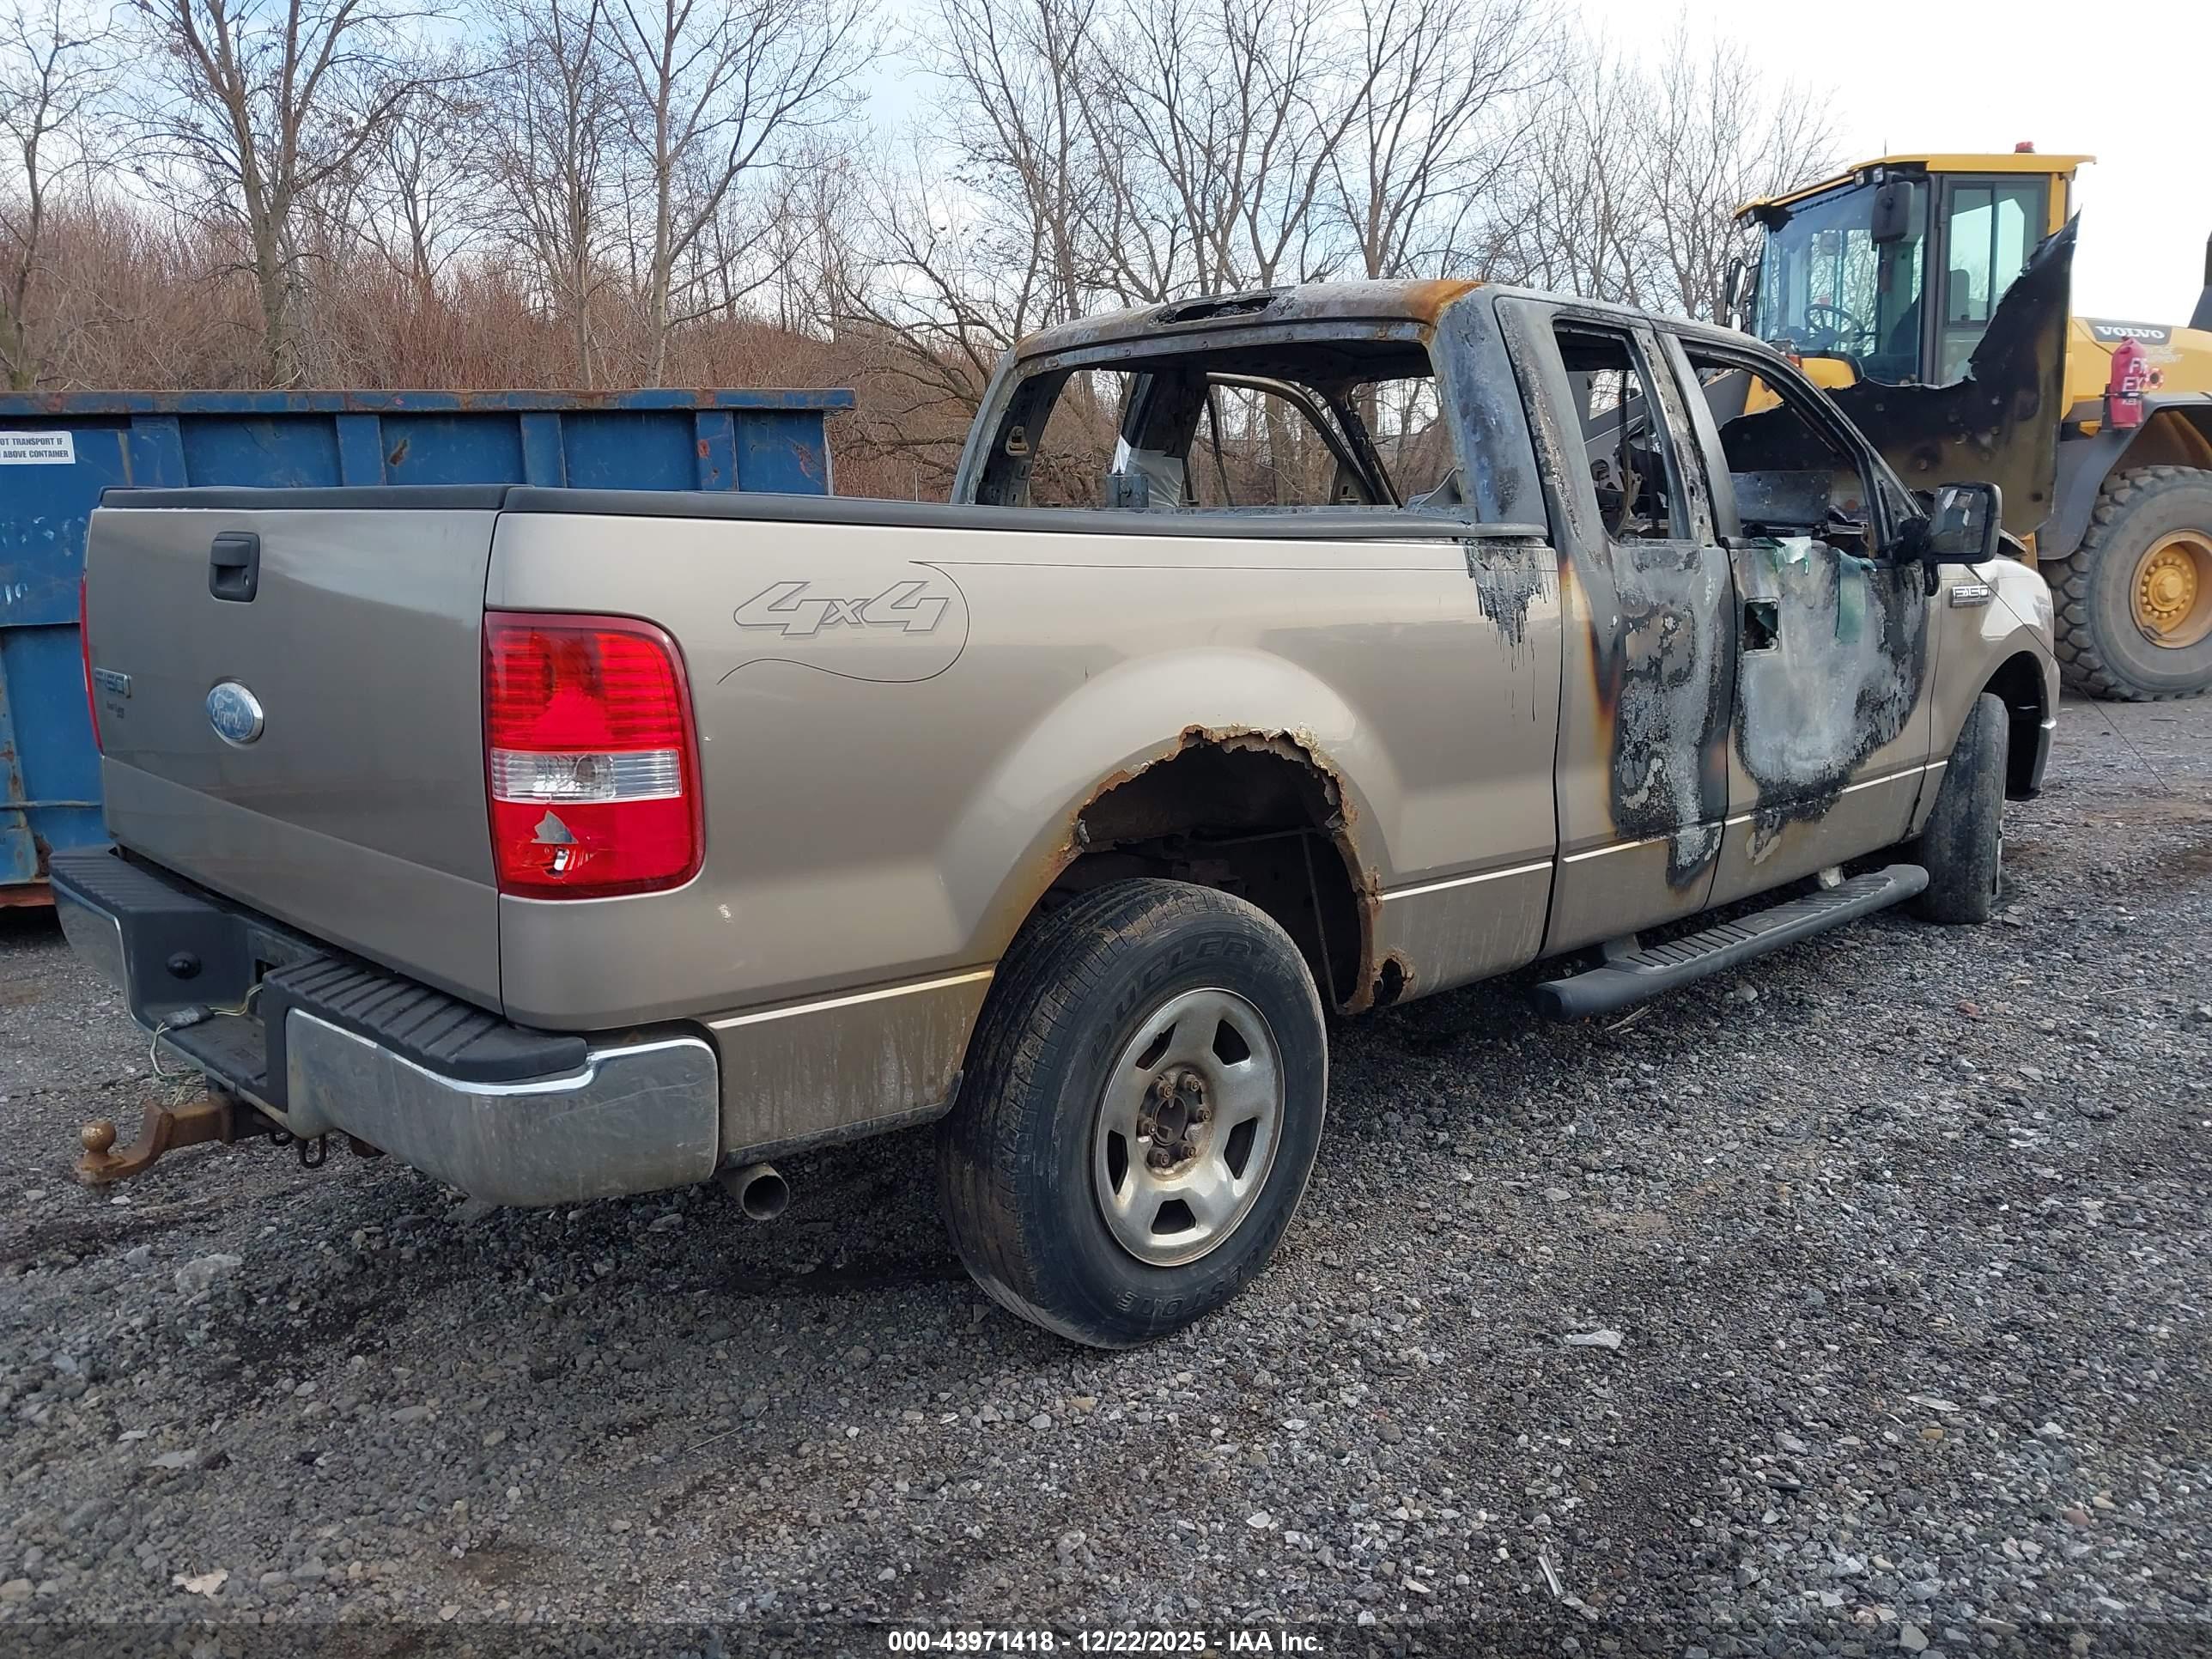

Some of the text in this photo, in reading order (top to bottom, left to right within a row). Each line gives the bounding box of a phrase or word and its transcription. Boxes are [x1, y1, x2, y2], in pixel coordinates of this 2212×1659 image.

[2095, 326, 2166, 339] VOLVO
[12, 437, 54, 446] TRANSPORT
[57, 437, 63, 446] IF
[3, 449, 69, 459] ABOVE CONTAINER
[733, 580, 951, 639] 4x4
[212, 693, 240, 729] Ford
